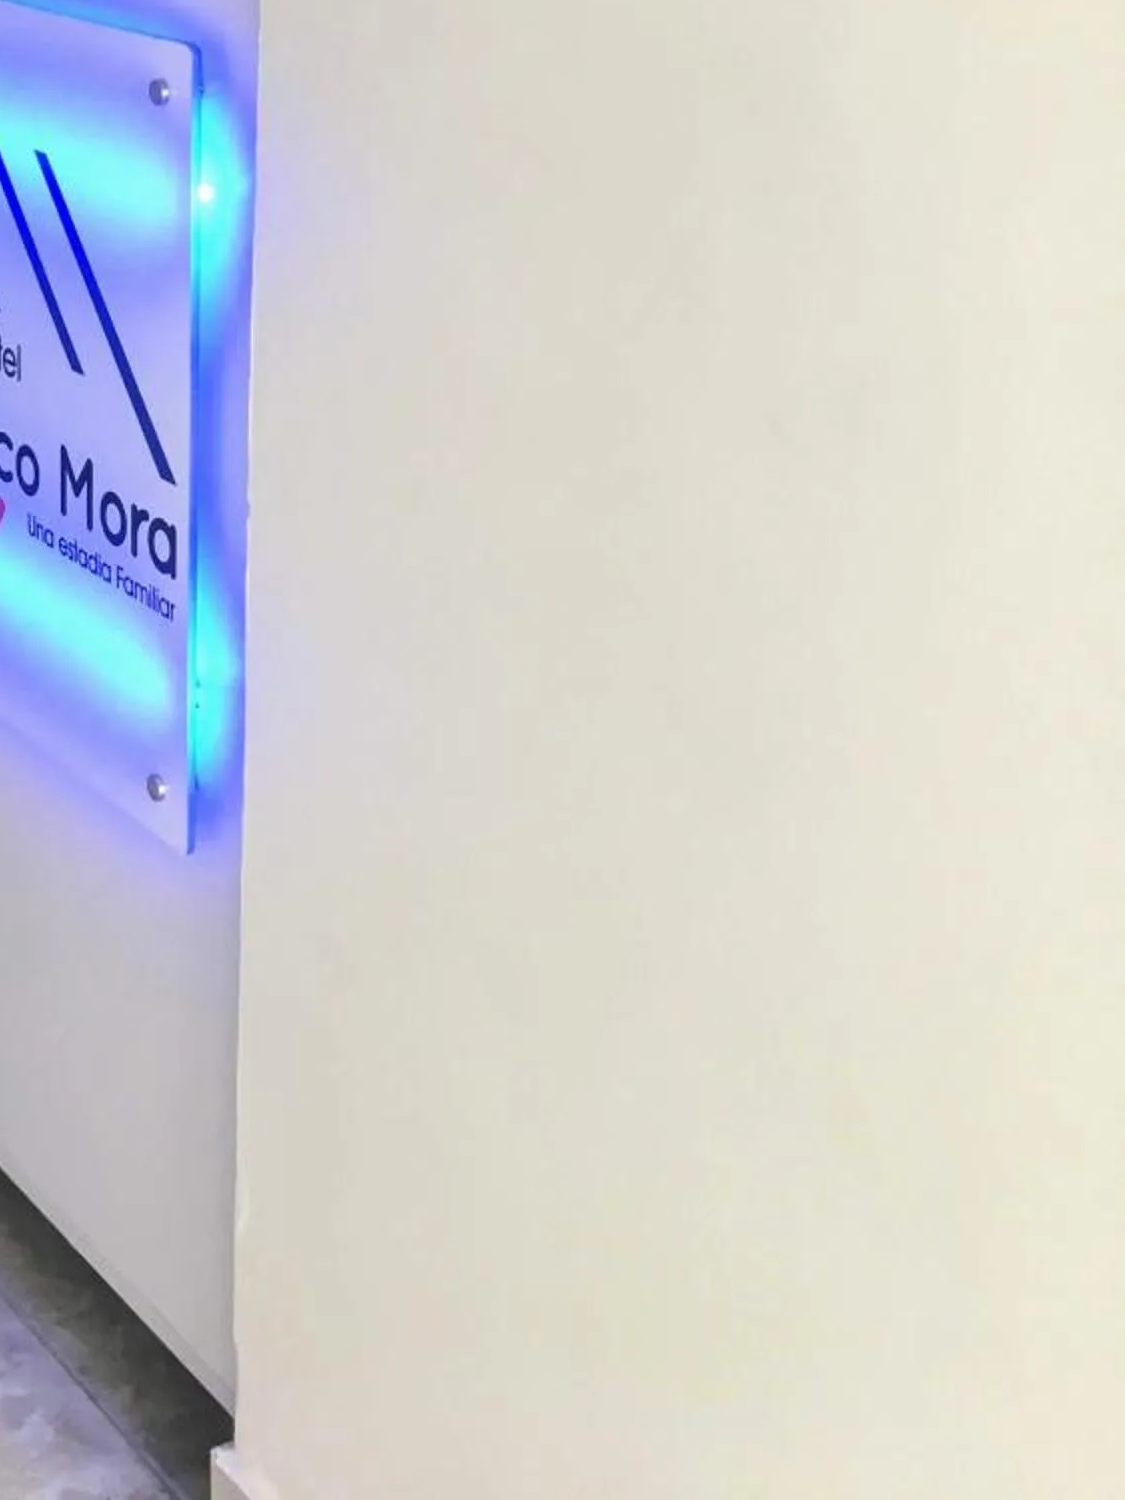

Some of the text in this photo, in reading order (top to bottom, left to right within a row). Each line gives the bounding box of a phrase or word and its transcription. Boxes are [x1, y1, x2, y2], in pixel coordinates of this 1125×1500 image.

[27, 513, 55, 549] Una
[116, 563, 176, 622] Familiar
[59, 444, 177, 580] Mora
